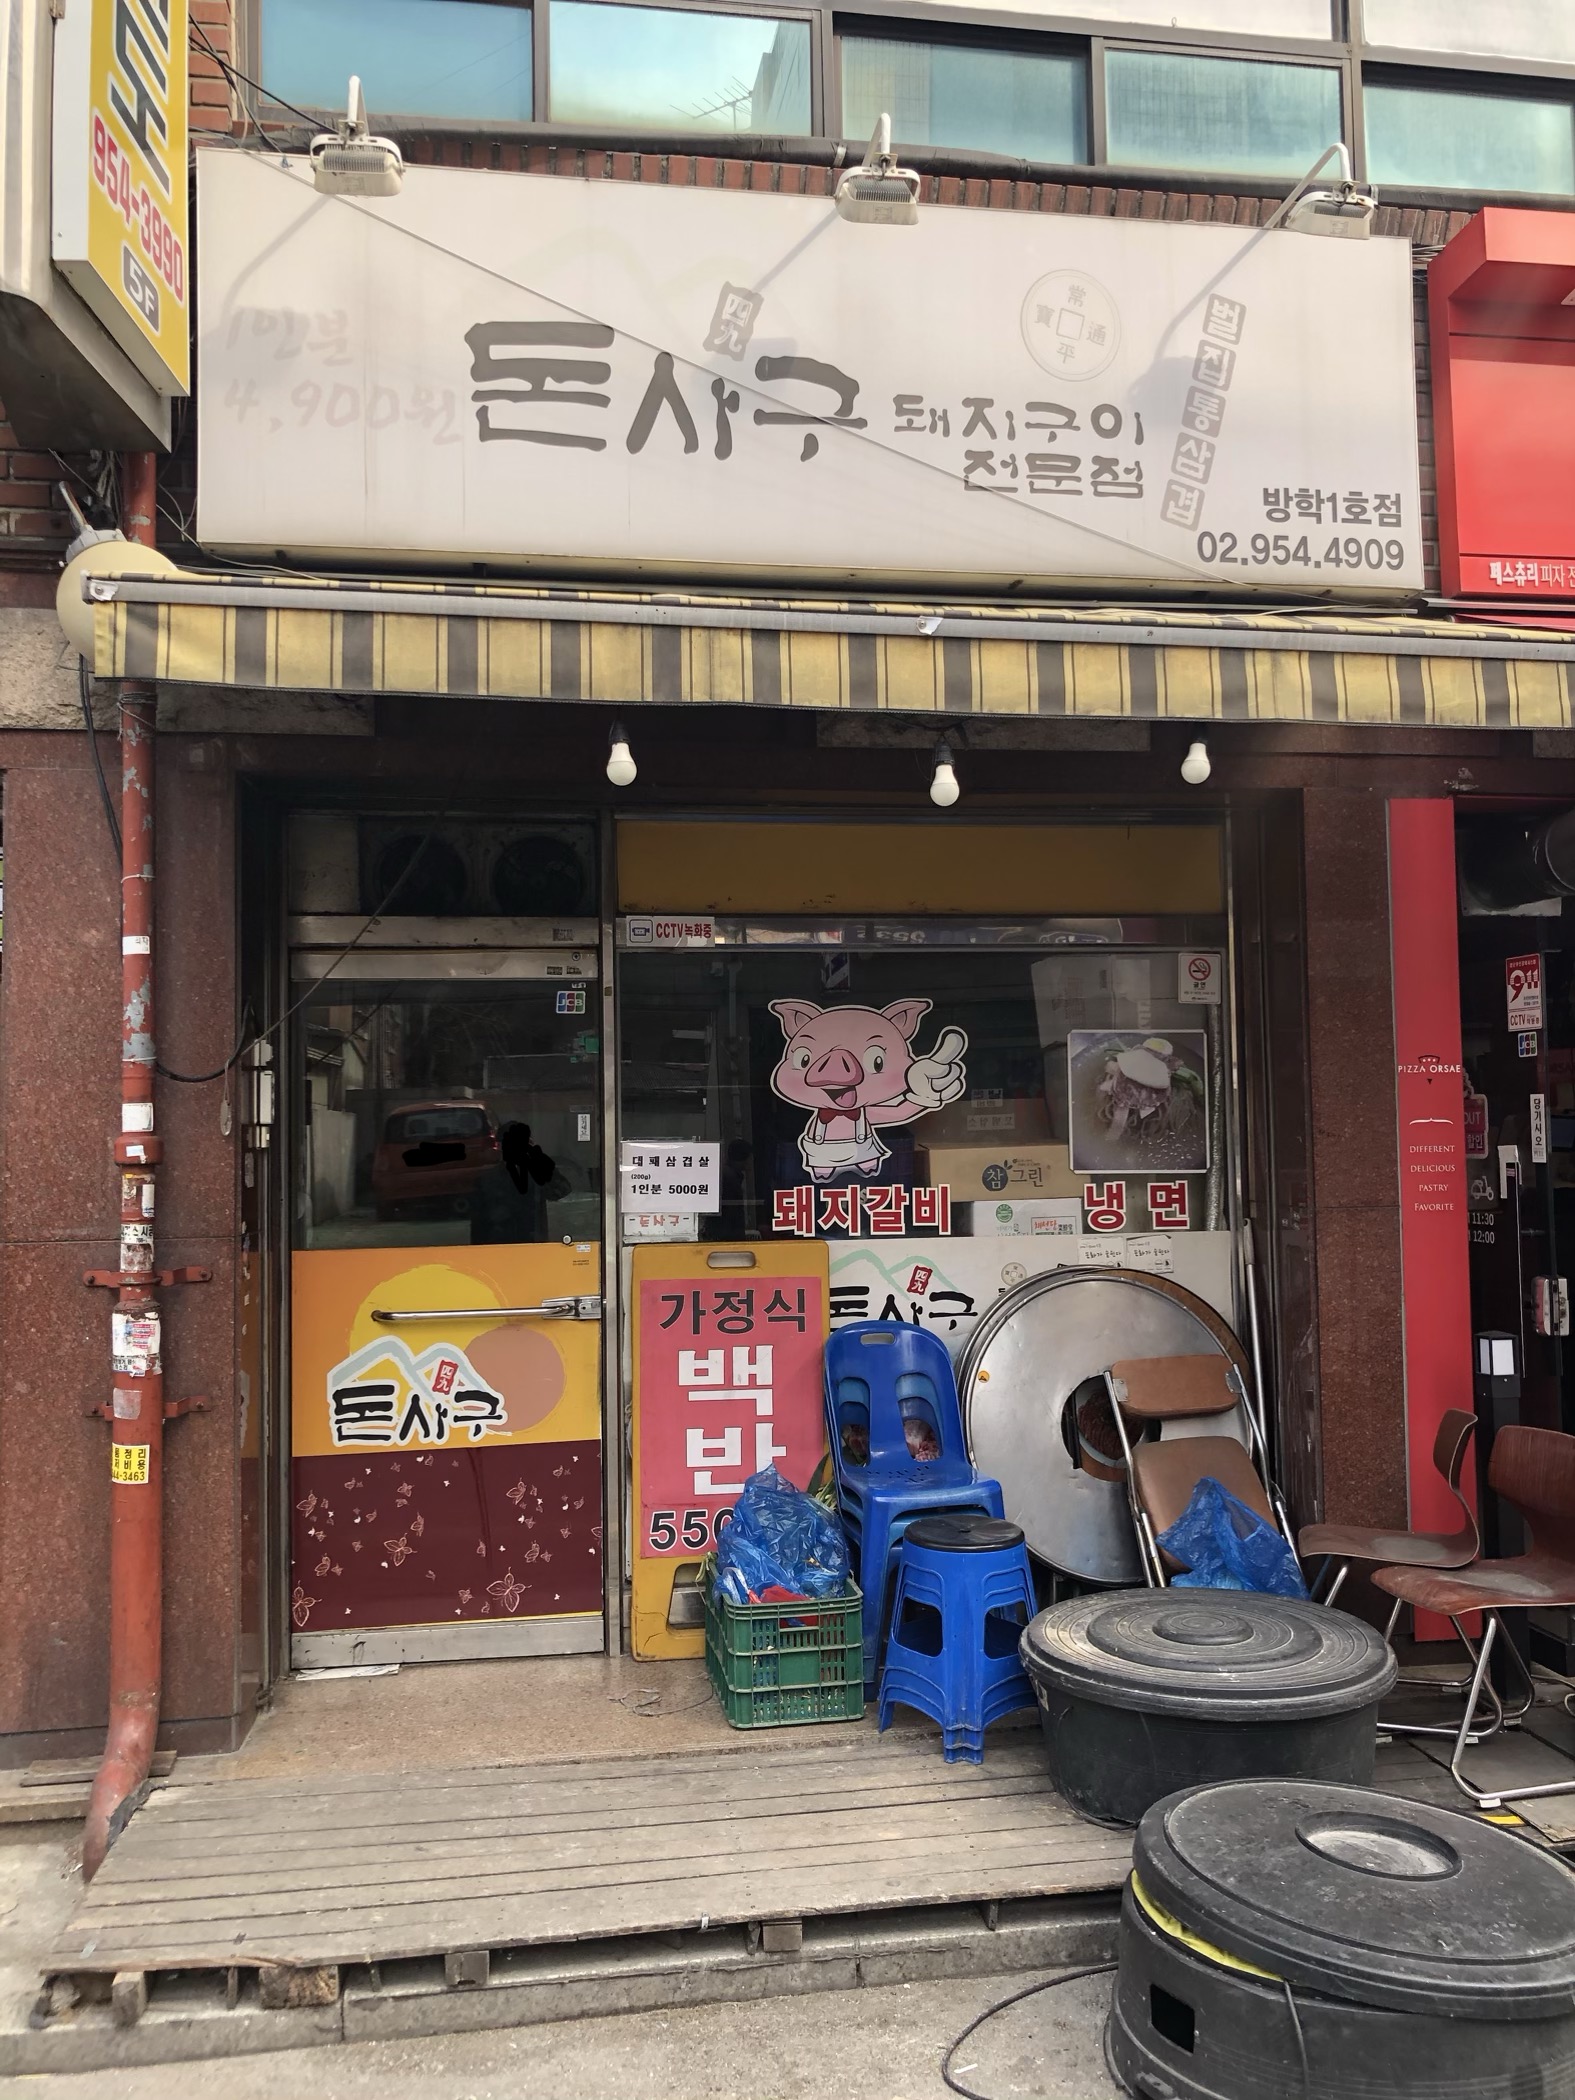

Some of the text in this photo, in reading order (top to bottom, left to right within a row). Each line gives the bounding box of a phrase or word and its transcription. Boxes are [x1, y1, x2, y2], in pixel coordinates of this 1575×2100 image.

[93, 113, 184, 304] 954-3990
[128, 257, 155, 317] 5F
[892, 393, 1145, 446] 돼지구이
[963, 448, 1144, 499] 전문점
[1263, 486, 1402, 528] 방학1호점
[1196, 531, 1405, 570] 02.954.4909
[1540, 563, 1565, 588] 피자
[1510, 968, 1539, 1004] 911
[1398, 1064, 1462, 1073] PIZZA ORSAE
[1533, 1098, 1543, 1146] 당기시오
[1409, 1144, 1456, 1154] DIFFERENT
[1410, 1164, 1456, 1173] DELICIOUS
[631, 1184, 709, 1196] 1인분 5000원
[1418, 1183, 1449, 1193] PASTRY
[772, 1184, 953, 1236] 돼지갈비
[1414, 1202, 1455, 1212] FAVORITE
[1472, 1211, 1495, 1226] 11:30
[1473, 1229, 1496, 1244] 12:00
[659, 1287, 807, 1336] 가정식
